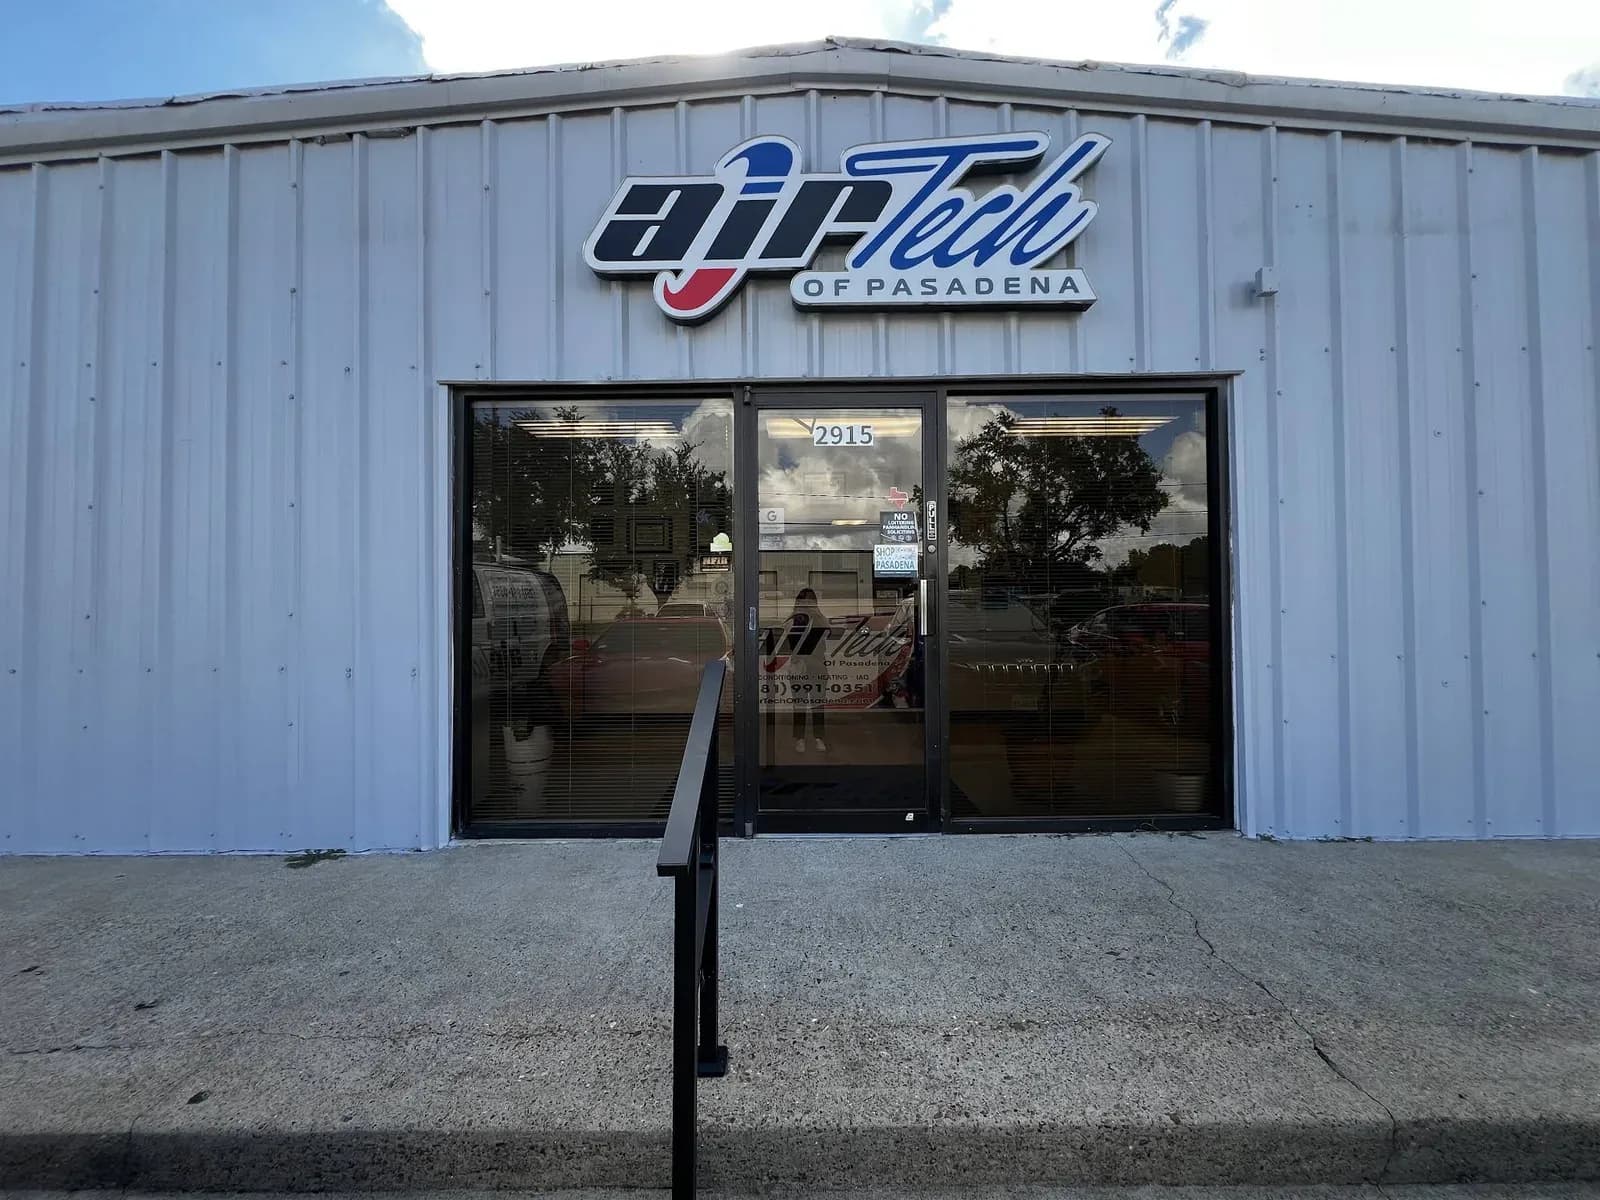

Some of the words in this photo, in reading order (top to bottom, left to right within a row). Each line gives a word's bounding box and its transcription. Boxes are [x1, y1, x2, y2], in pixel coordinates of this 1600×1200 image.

[845, 140, 1098, 269] Tech
[803, 278, 848, 297] OF
[867, 276, 1079, 296] PASADENA
[815, 425, 873, 445] 2915
[767, 510, 777, 521] G
[876, 547, 895, 557] SHOP
[876, 561, 915, 569] PASADENA
